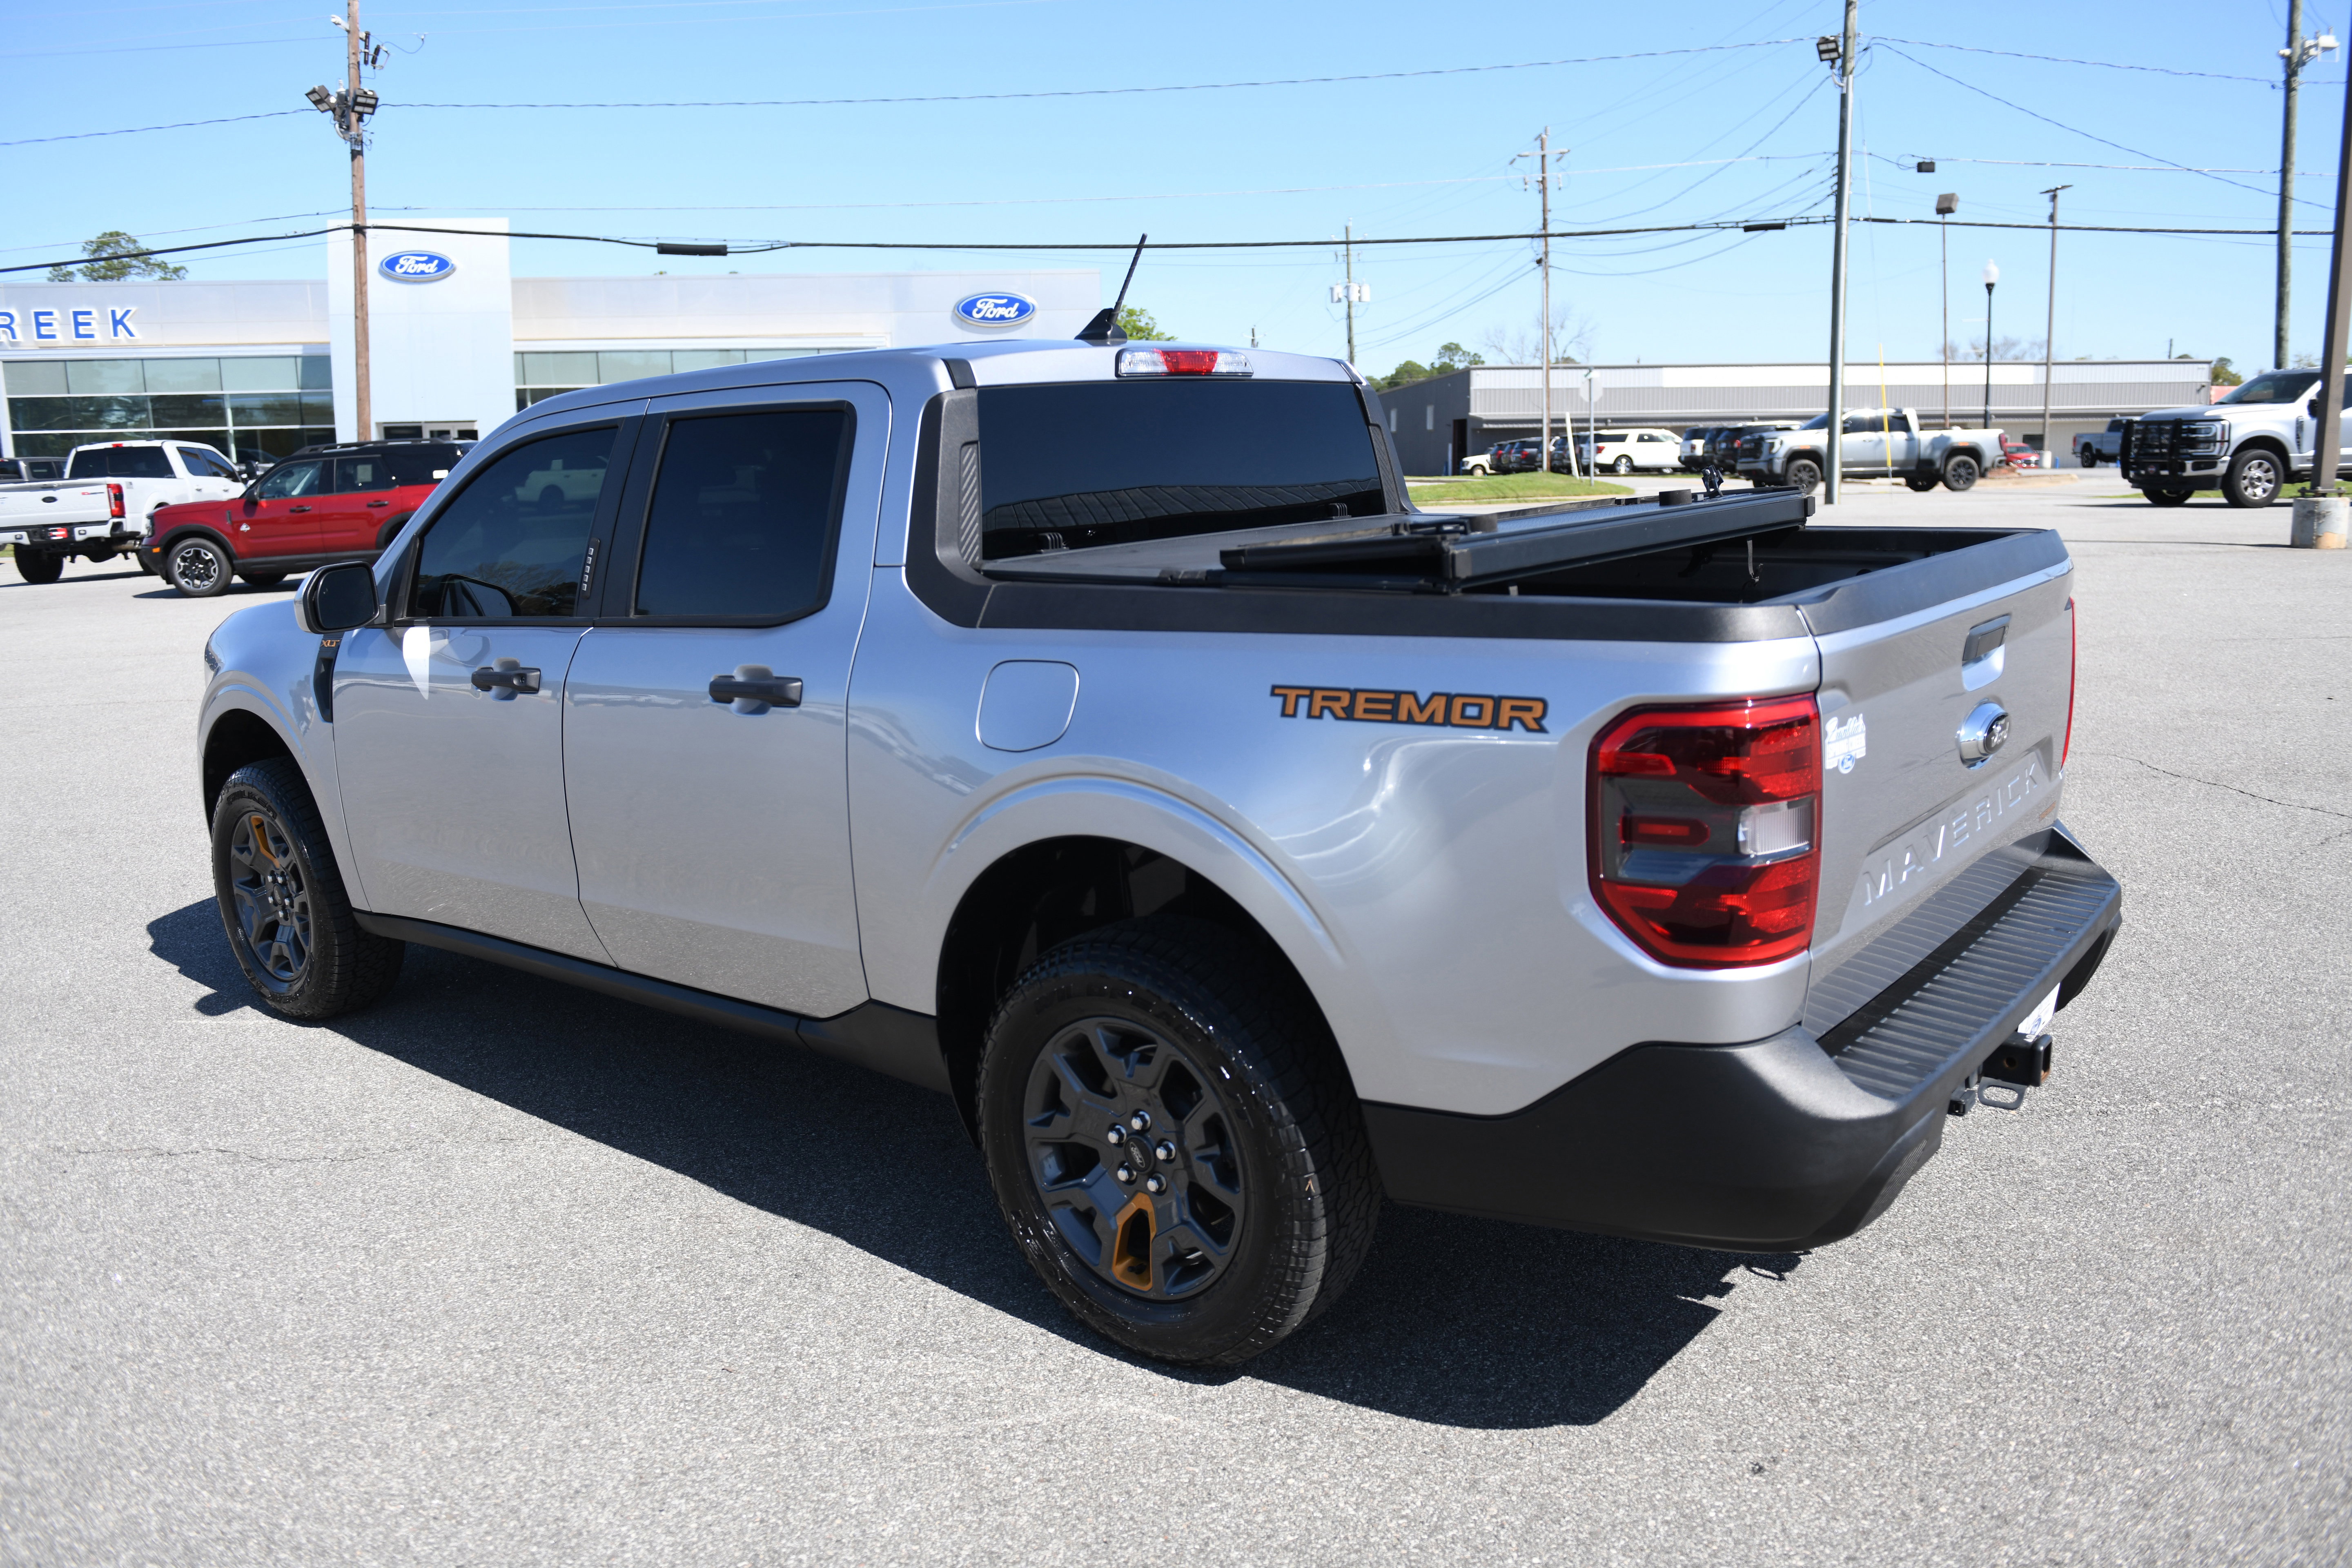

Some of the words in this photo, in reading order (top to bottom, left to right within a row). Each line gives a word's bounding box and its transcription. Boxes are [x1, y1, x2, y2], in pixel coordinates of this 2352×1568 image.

[395, 256, 439, 273] Ford
[972, 298, 1020, 318] Ford
[0, 308, 136, 340] REEK
[1270, 685, 1550, 734] TREMOR
[1991, 718, 2009, 748] Ford
[1843, 755, 1853, 768] Ford
[1862, 762, 2038, 906] MAVERICK
[1033, 982, 1204, 1045] WILDPEAK
